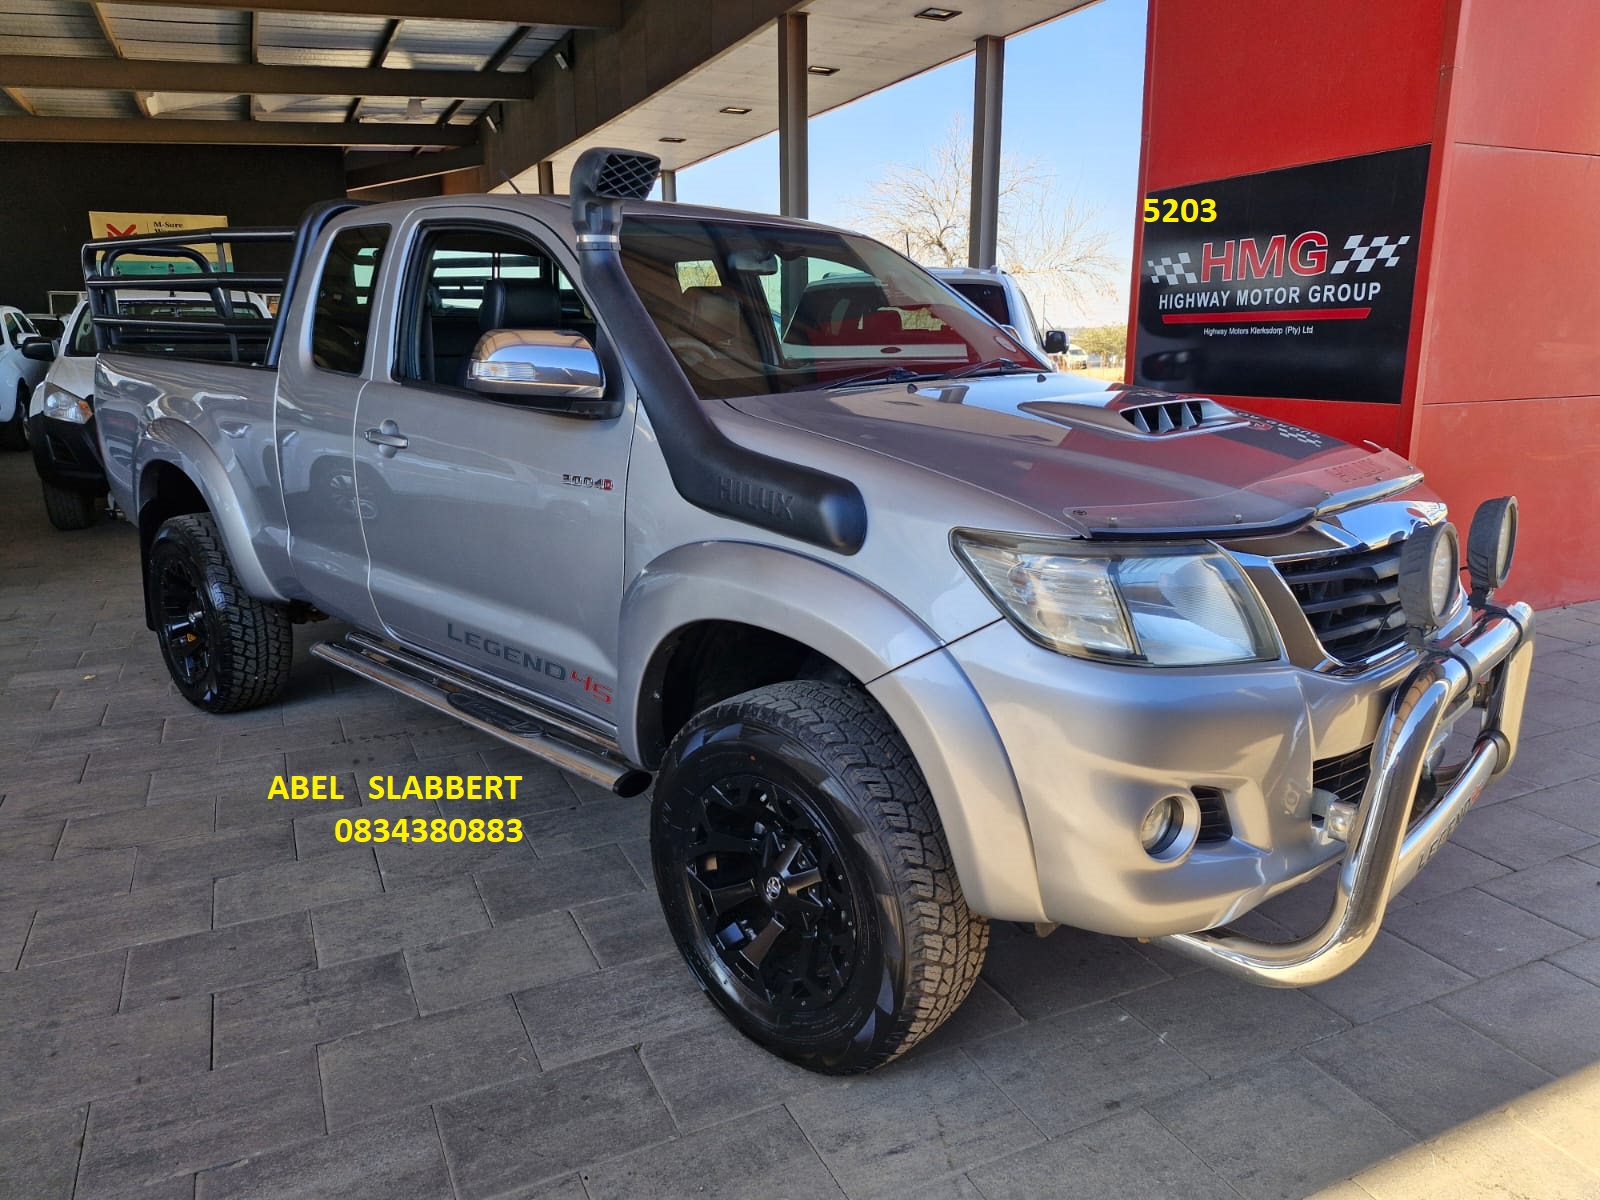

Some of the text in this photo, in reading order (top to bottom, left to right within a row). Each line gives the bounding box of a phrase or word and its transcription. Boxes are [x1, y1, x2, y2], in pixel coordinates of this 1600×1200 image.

[1200, 230, 1329, 283] HMG
[1158, 281, 1382, 311] HIGHWAY MOTOR GROUP
[1203, 327, 1227, 337] Highway
[1229, 326, 1249, 335] Motors
[1285, 325, 1301, 336] (Pty)
[1302, 325, 1314, 335] Ltd
[718, 475, 793, 521] HILUX
[447, 623, 613, 704] LEGEND 45
